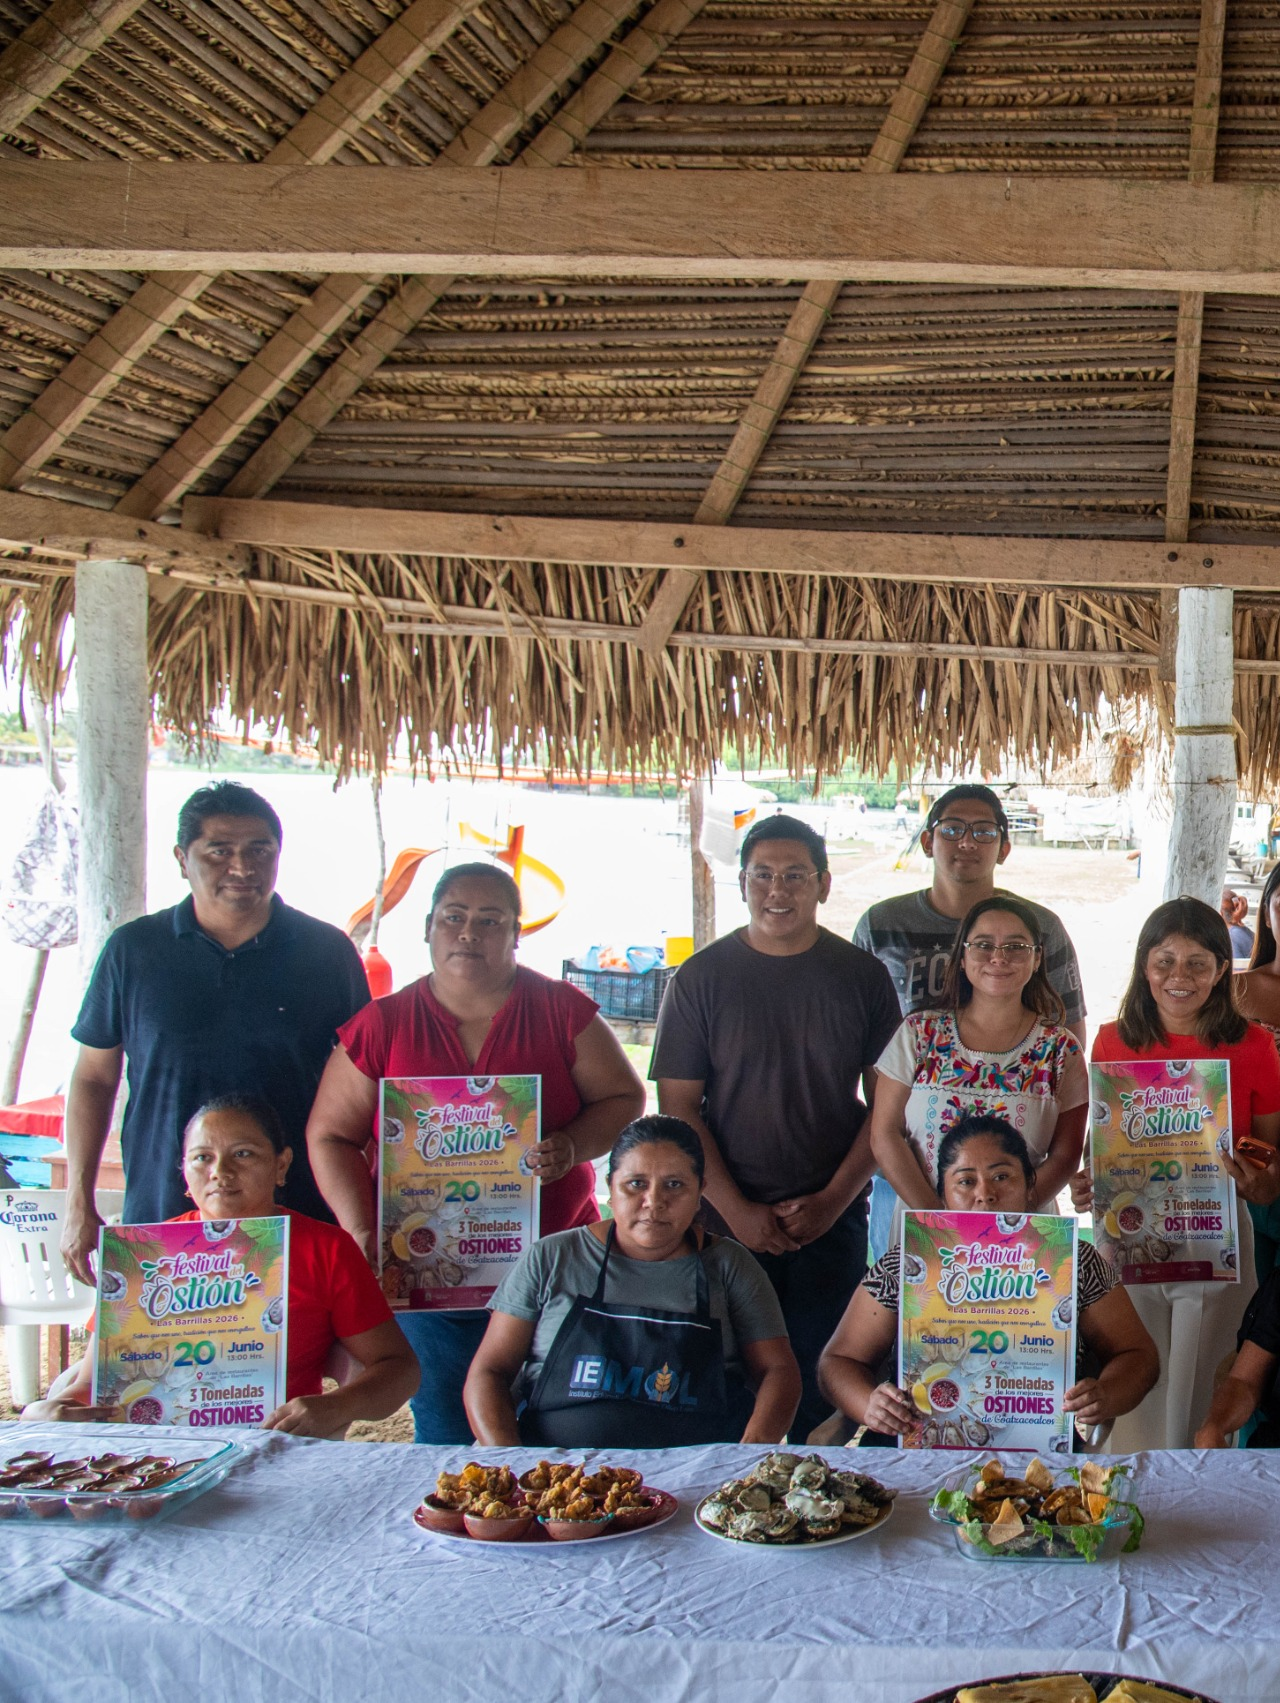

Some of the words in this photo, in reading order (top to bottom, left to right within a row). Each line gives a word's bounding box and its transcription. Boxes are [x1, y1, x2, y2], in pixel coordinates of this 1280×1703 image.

[1126, 1106, 1202, 1140] Ostión
[421, 1124, 503, 1159] Ostión
[1148, 1140, 1178, 1148] Barrillas
[1109, 1167, 1141, 1176] Sábado
[1150, 1160, 1183, 1182] 20
[1191, 1162, 1219, 1172] Junio
[400, 1186, 435, 1196] Sábado
[444, 1180, 481, 1202] 20
[490, 1183, 522, 1193] Junio
[1163, 1200, 1170, 1211] 3
[1172, 1200, 1222, 1210] Toneladas
[0, 1211, 57, 1226] Corona
[459, 1221, 465, 1233] 3
[468, 1219, 522, 1232] Toneladas
[1164, 1216, 1223, 1232] OSTIONES
[16, 1224, 48, 1233] Extra
[458, 1237, 523, 1255] OSTIONES
[944, 1266, 1035, 1304] Ostión
[147, 1275, 245, 1318] Ostión
[953, 1306, 968, 1314] Las
[970, 1306, 1005, 1315] Barrillas
[157, 1319, 172, 1327] Las
[175, 1316, 212, 1326] Barrillas
[215, 1315, 238, 1324] 2026
[921, 1334, 959, 1345] Sábado
[969, 1330, 1010, 1355] 20
[1019, 1334, 1054, 1346] Junio
[120, 1349, 162, 1362] Sábado
[173, 1340, 217, 1367] 20
[227, 1341, 264, 1354] Junio
[984, 1375, 991, 1389] 3
[994, 1375, 1054, 1391] Toneladas
[189, 1387, 197, 1403] 3
[200, 1384, 264, 1401] Toneladas
[201, 1401, 210, 1409] de
[224, 1399, 253, 1407] mejores
[983, 1396, 1054, 1415] OSTIONES
[189, 1404, 264, 1428] OSTIONES
[981, 1414, 992, 1424] de
[994, 1414, 1056, 1425] Coatzacoalcos
